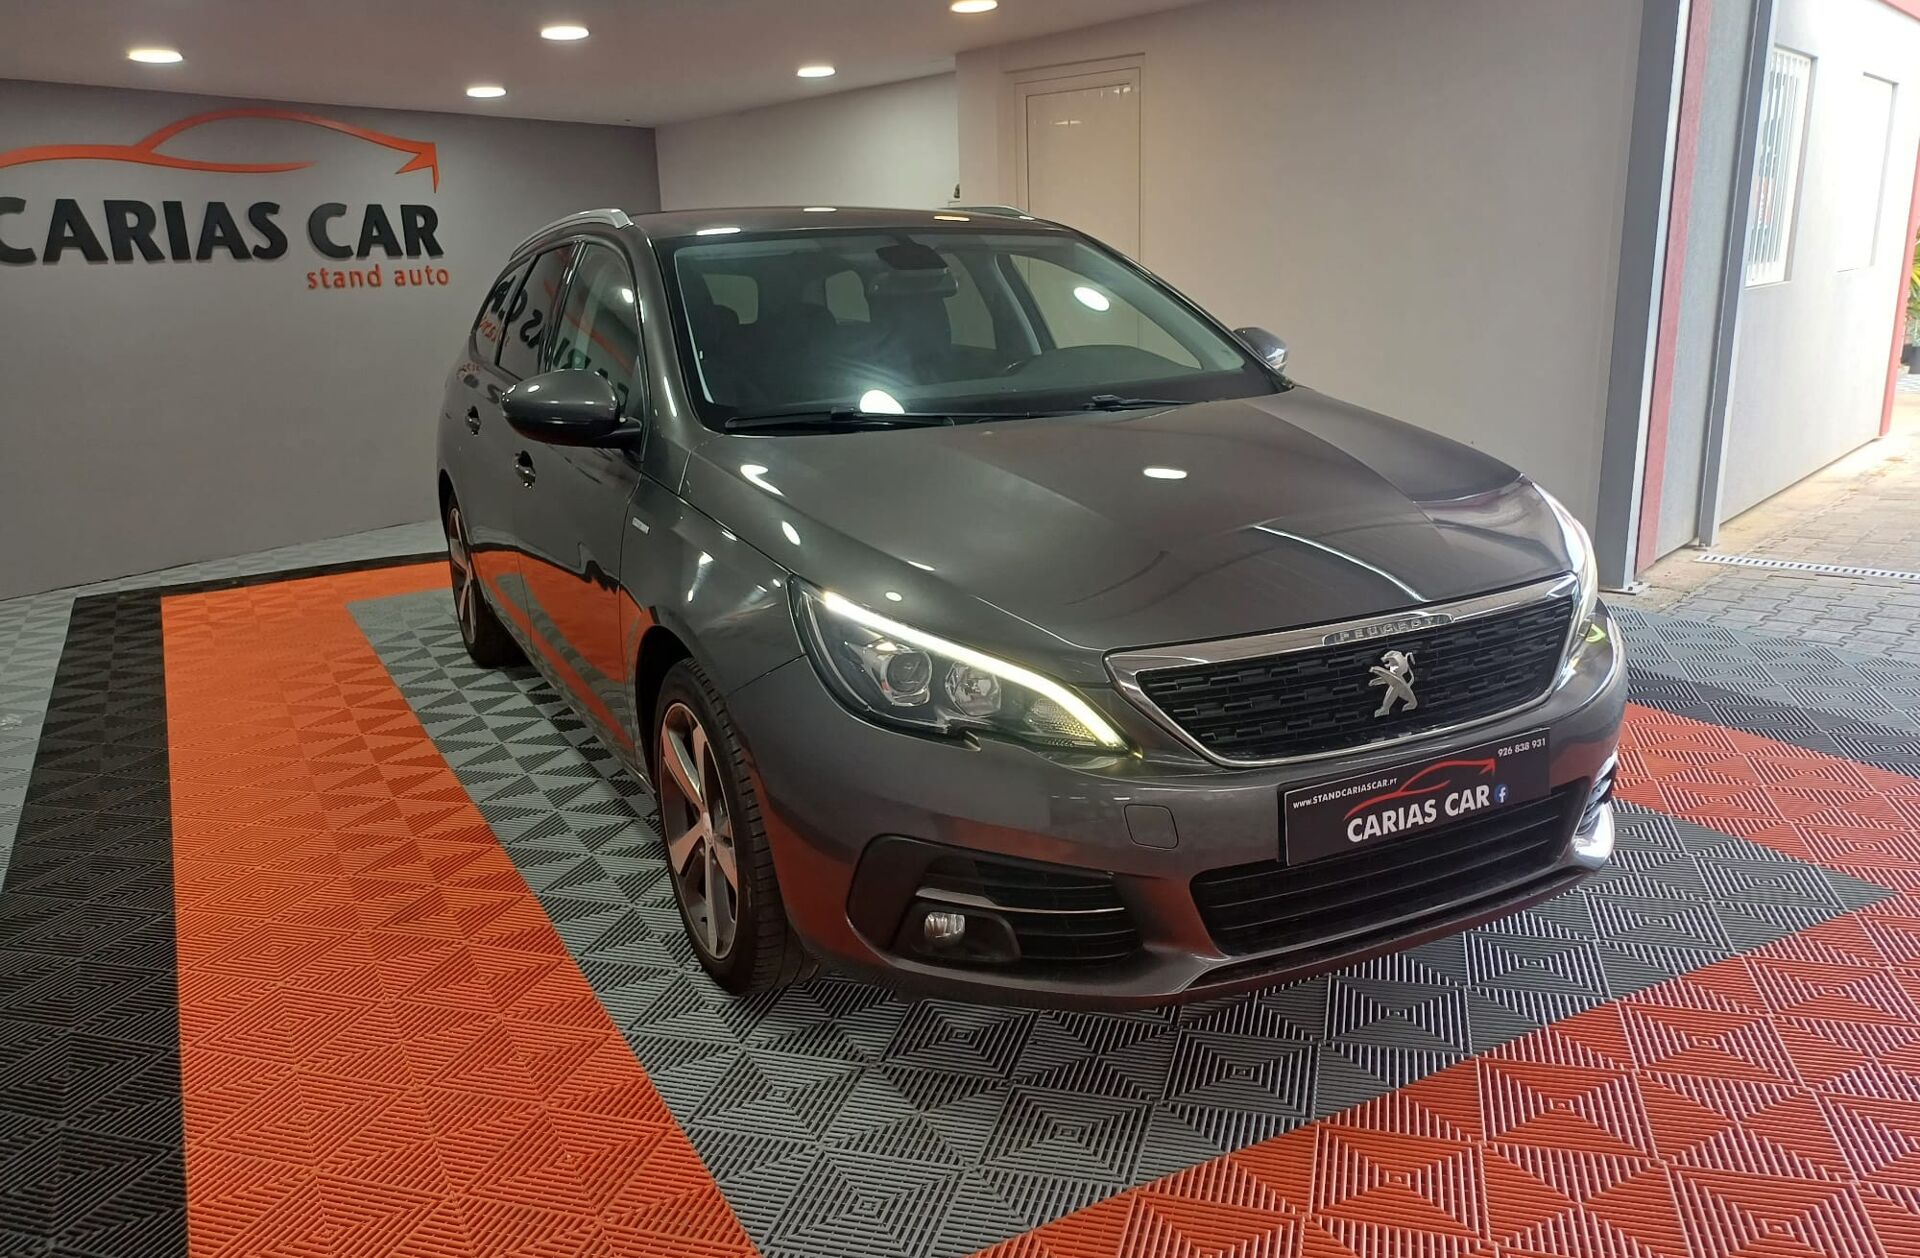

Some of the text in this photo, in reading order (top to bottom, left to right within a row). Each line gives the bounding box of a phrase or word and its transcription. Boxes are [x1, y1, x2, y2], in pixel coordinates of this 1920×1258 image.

[0, 197, 444, 263] CARIAS CAR
[307, 264, 450, 289] stand auto
[1339, 618, 1435, 642] PEUGEOT
[1497, 737, 1546, 758] 926 838 931
[1347, 784, 1490, 843] CARIAS CAR
